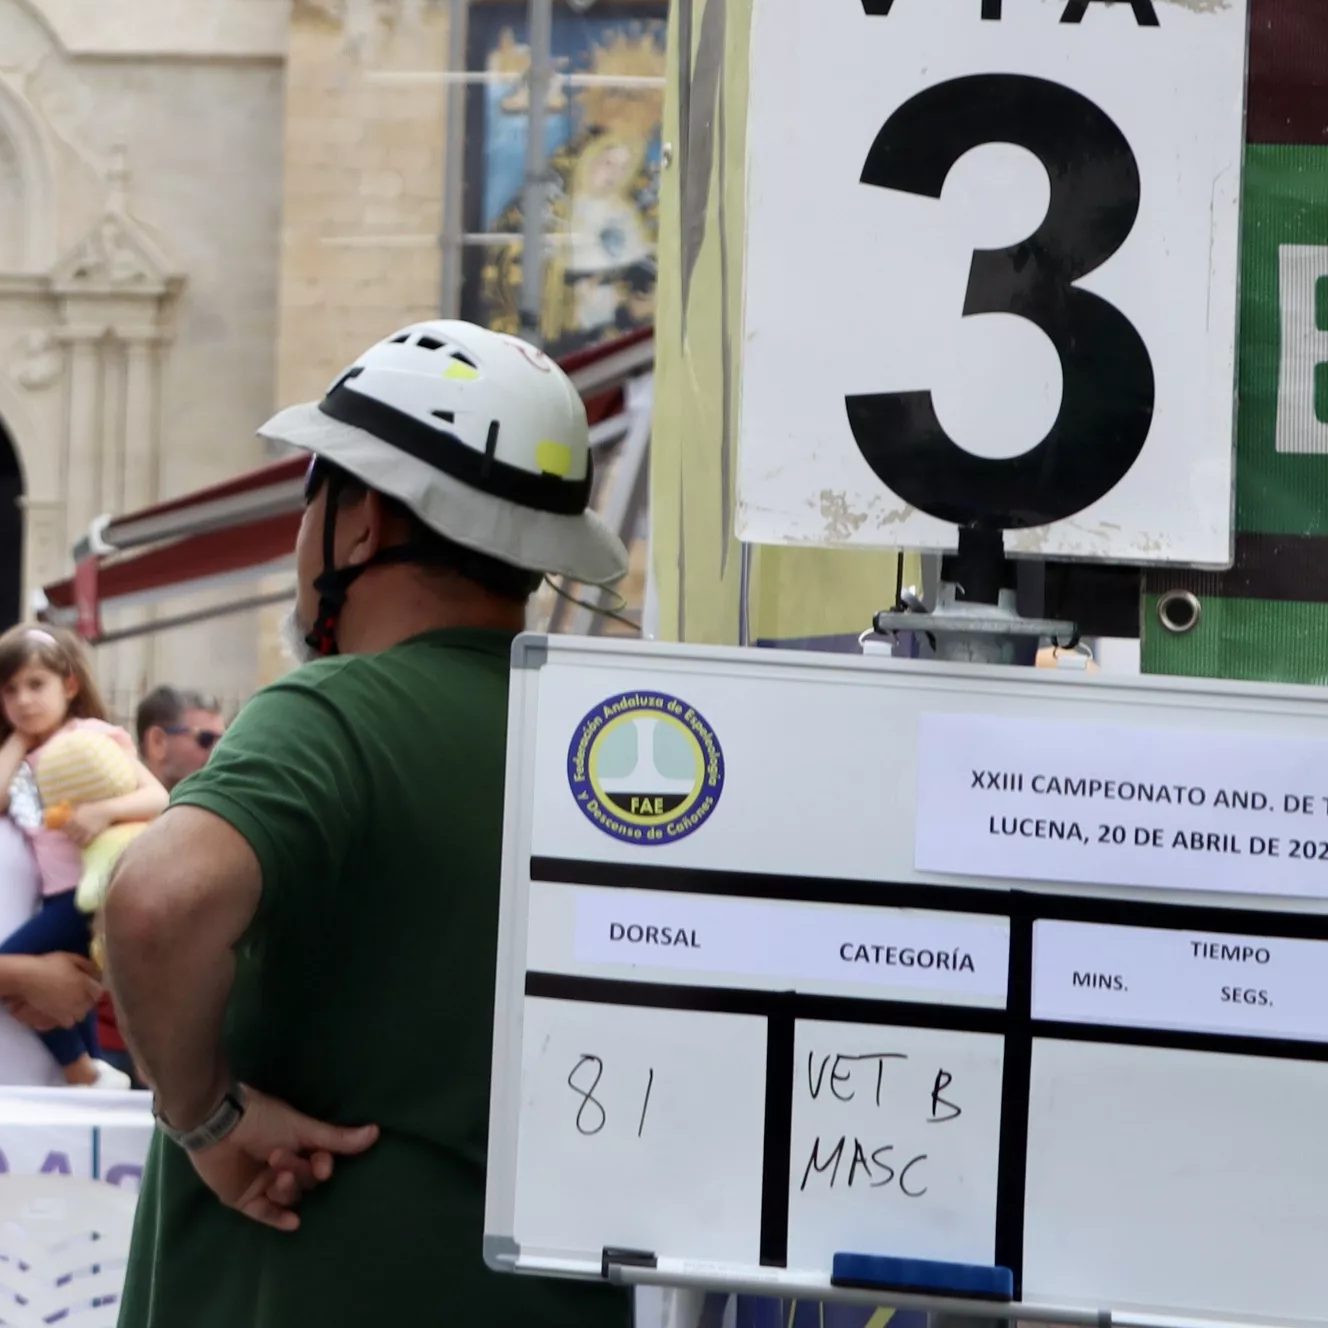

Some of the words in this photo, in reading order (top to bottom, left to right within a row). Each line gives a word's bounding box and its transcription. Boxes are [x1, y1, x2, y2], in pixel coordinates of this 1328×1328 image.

[844, 73, 1156, 530] 3
[573, 715, 603, 782] Federación
[602, 694, 664, 719] Andaluza
[667, 699, 683, 715] de
[631, 797, 664, 814] FAE
[971, 770, 1023, 793] XXIII
[1031, 774, 1206, 807] CAMPEONATO
[1213, 789, 1274, 813] AND.
[1283, 794, 1315, 815] DE
[587, 799, 643, 839] Descenso
[647, 827, 663, 839] de
[667, 796, 714, 835] Cañones
[989, 816, 1090, 846] LUCENA,
[1097, 824, 1126, 845] 20
[1134, 827, 1164, 848] DE
[1172, 830, 1242, 855] ABRIL
[1249, 836, 1280, 857] DE
[609, 922, 702, 949] DORSAL
[839, 942, 976, 973] CATEGORÍA
[1191, 941, 1271, 965] TIEMPO
[1072, 971, 1128, 992] MINS.
[1220, 986, 1274, 1008] SEGS.
[568, 1053, 654, 1137] 81
[806, 1050, 908, 1107] VET
[926, 1069, 963, 1122] B
[800, 1135, 929, 1198] MASC
